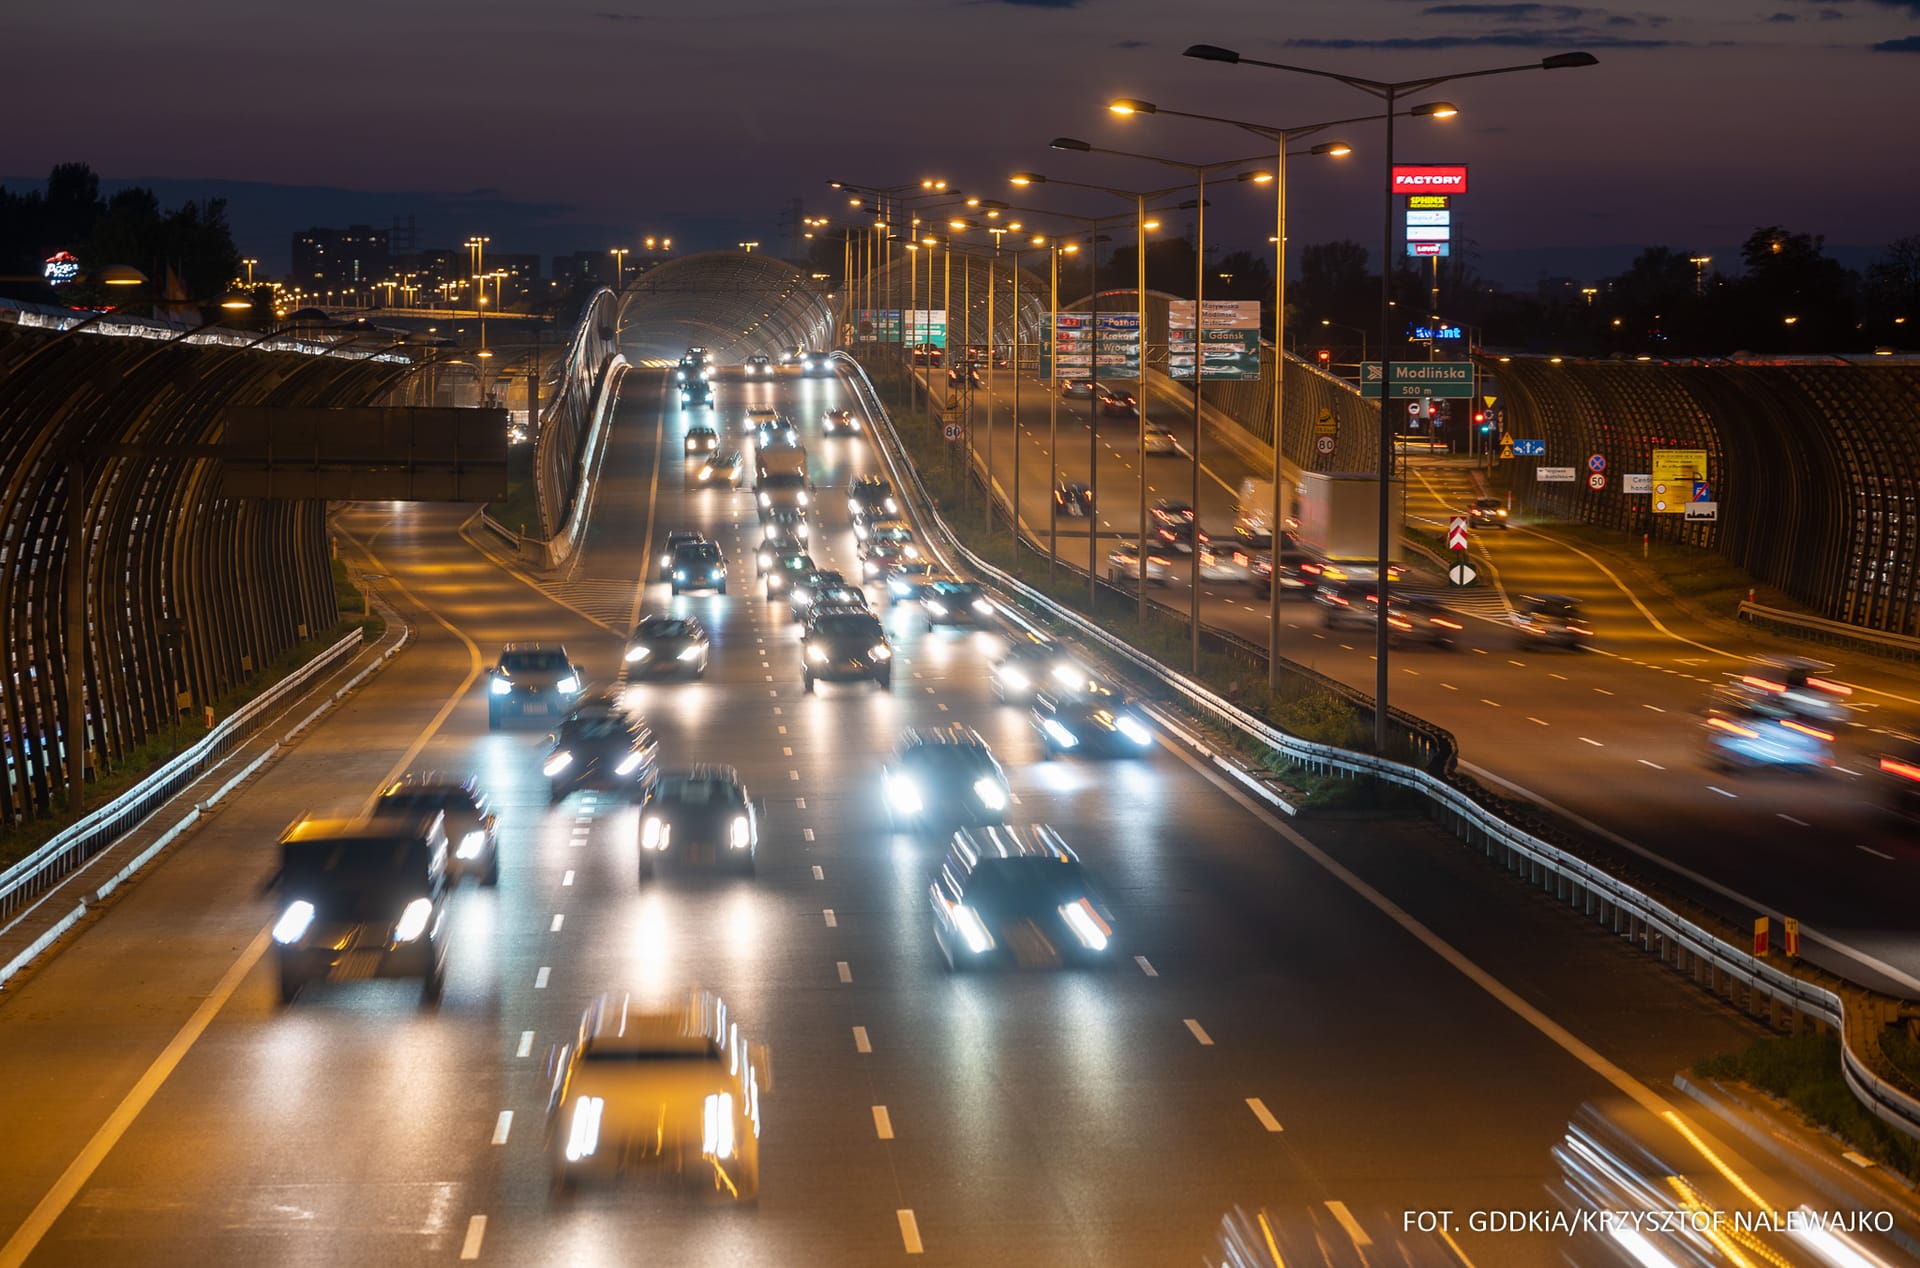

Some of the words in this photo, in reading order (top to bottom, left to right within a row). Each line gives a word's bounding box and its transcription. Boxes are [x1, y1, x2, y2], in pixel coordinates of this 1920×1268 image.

[1396, 175, 1462, 185] FACTORY
[1103, 343, 1140, 351] Wrocła
[1396, 366, 1466, 379] Modlińska
[1402, 386, 1420, 395] 500
[946, 426, 961, 437] 80
[1319, 439, 1333, 450] 80
[1592, 477, 1604, 486] 50
